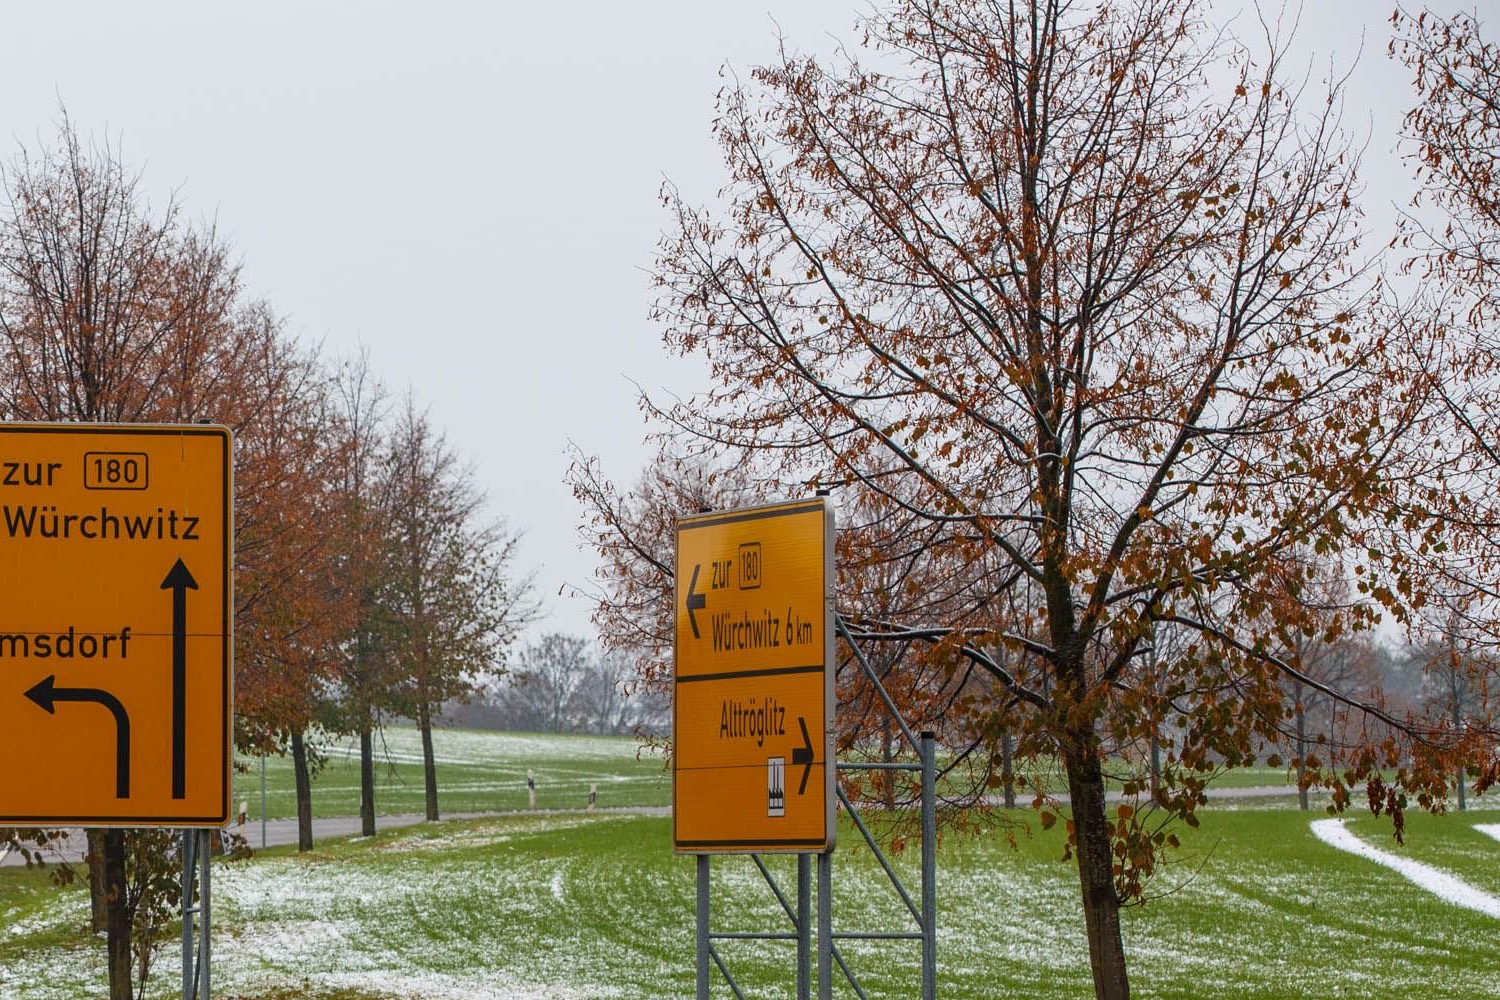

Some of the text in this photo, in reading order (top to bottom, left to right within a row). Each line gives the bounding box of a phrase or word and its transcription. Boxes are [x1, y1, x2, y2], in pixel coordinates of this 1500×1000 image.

[3, 459, 137, 486] zur 180
[3, 506, 200, 540] Würchwitz
[712, 551, 757, 589] zur 180
[712, 607, 812, 653] Würchwitz 6 km
[719, 697, 785, 747] Alttröglitz
